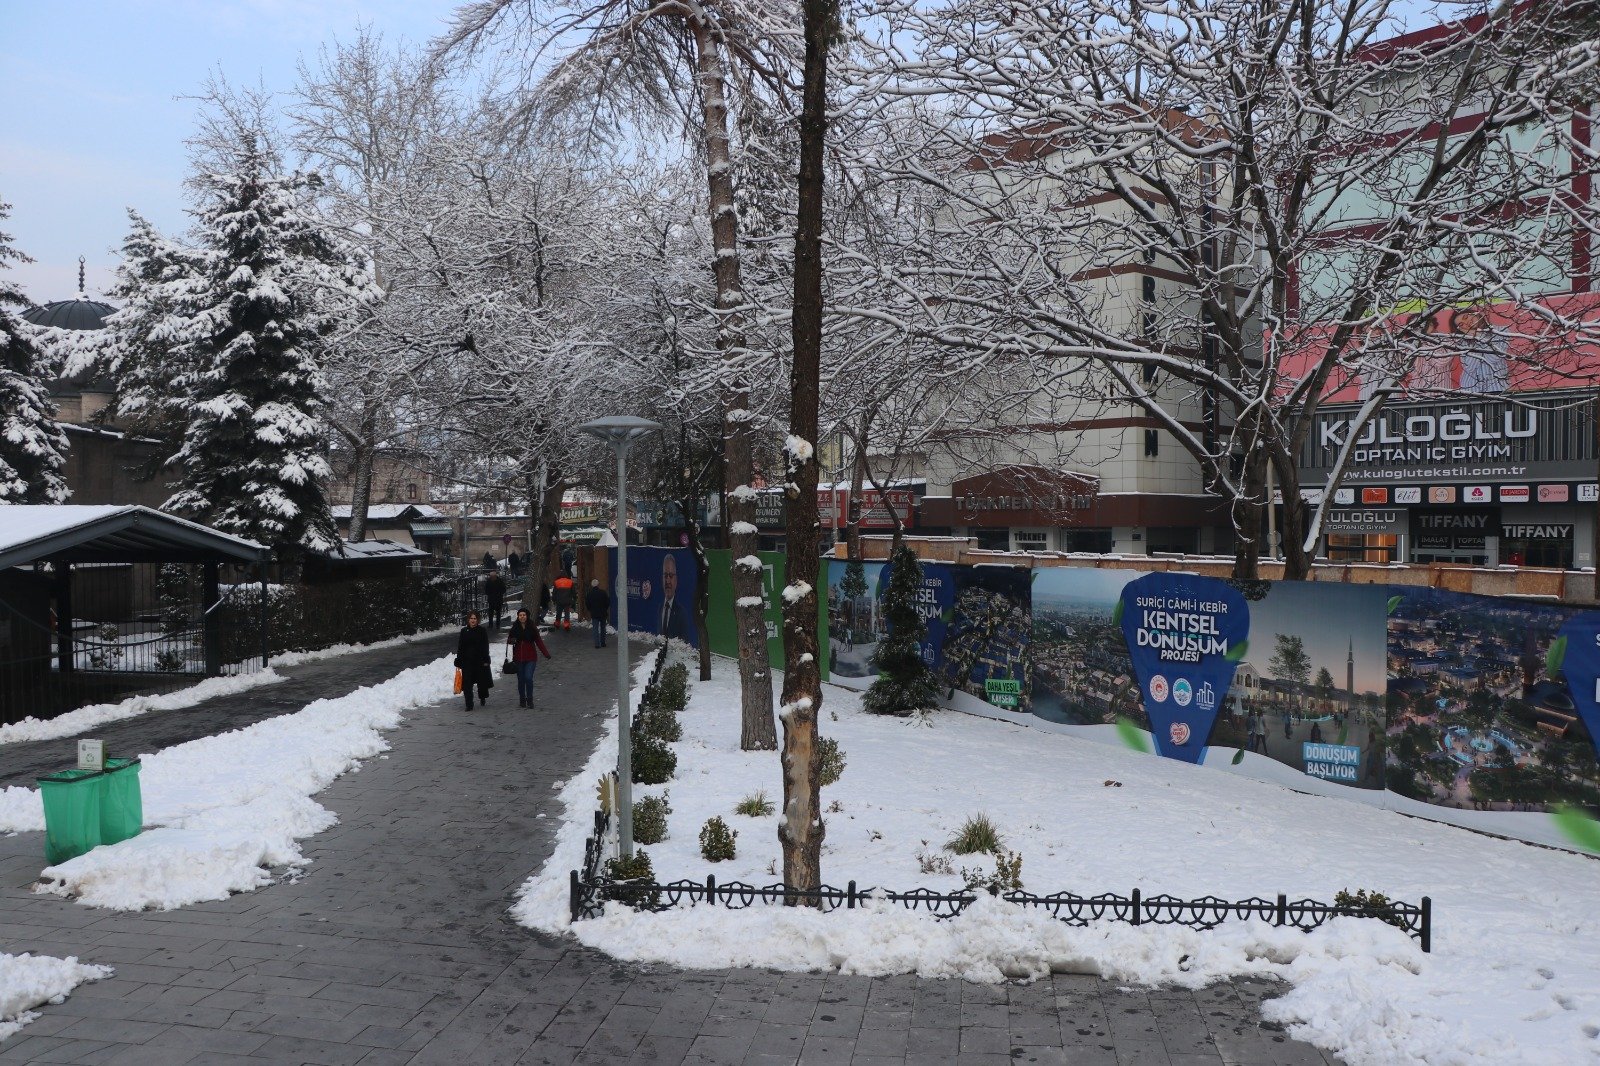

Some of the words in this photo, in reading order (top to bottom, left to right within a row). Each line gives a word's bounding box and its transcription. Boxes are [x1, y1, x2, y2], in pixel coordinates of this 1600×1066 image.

[1320, 409, 1537, 446] KULOĞLU
[1351, 447, 1421, 462] OPTAN
[1452, 442, 1511, 459] GİYİM
[1325, 511, 1396, 523] ULOĞLU
[1419, 515, 1489, 528] TIFFANY
[1013, 531, 1047, 541] TÜRKMEN
[1502, 525, 1570, 538] TIFFANY
[1136, 596, 1166, 609] SURİÇİ
[1143, 610, 1220, 635] KENTSEL
[1160, 649, 1200, 662] PROJESİ
[1306, 743, 1357, 764] DÖNÜŞÜM
[1307, 761, 1356, 779] BAŞLIYOR
